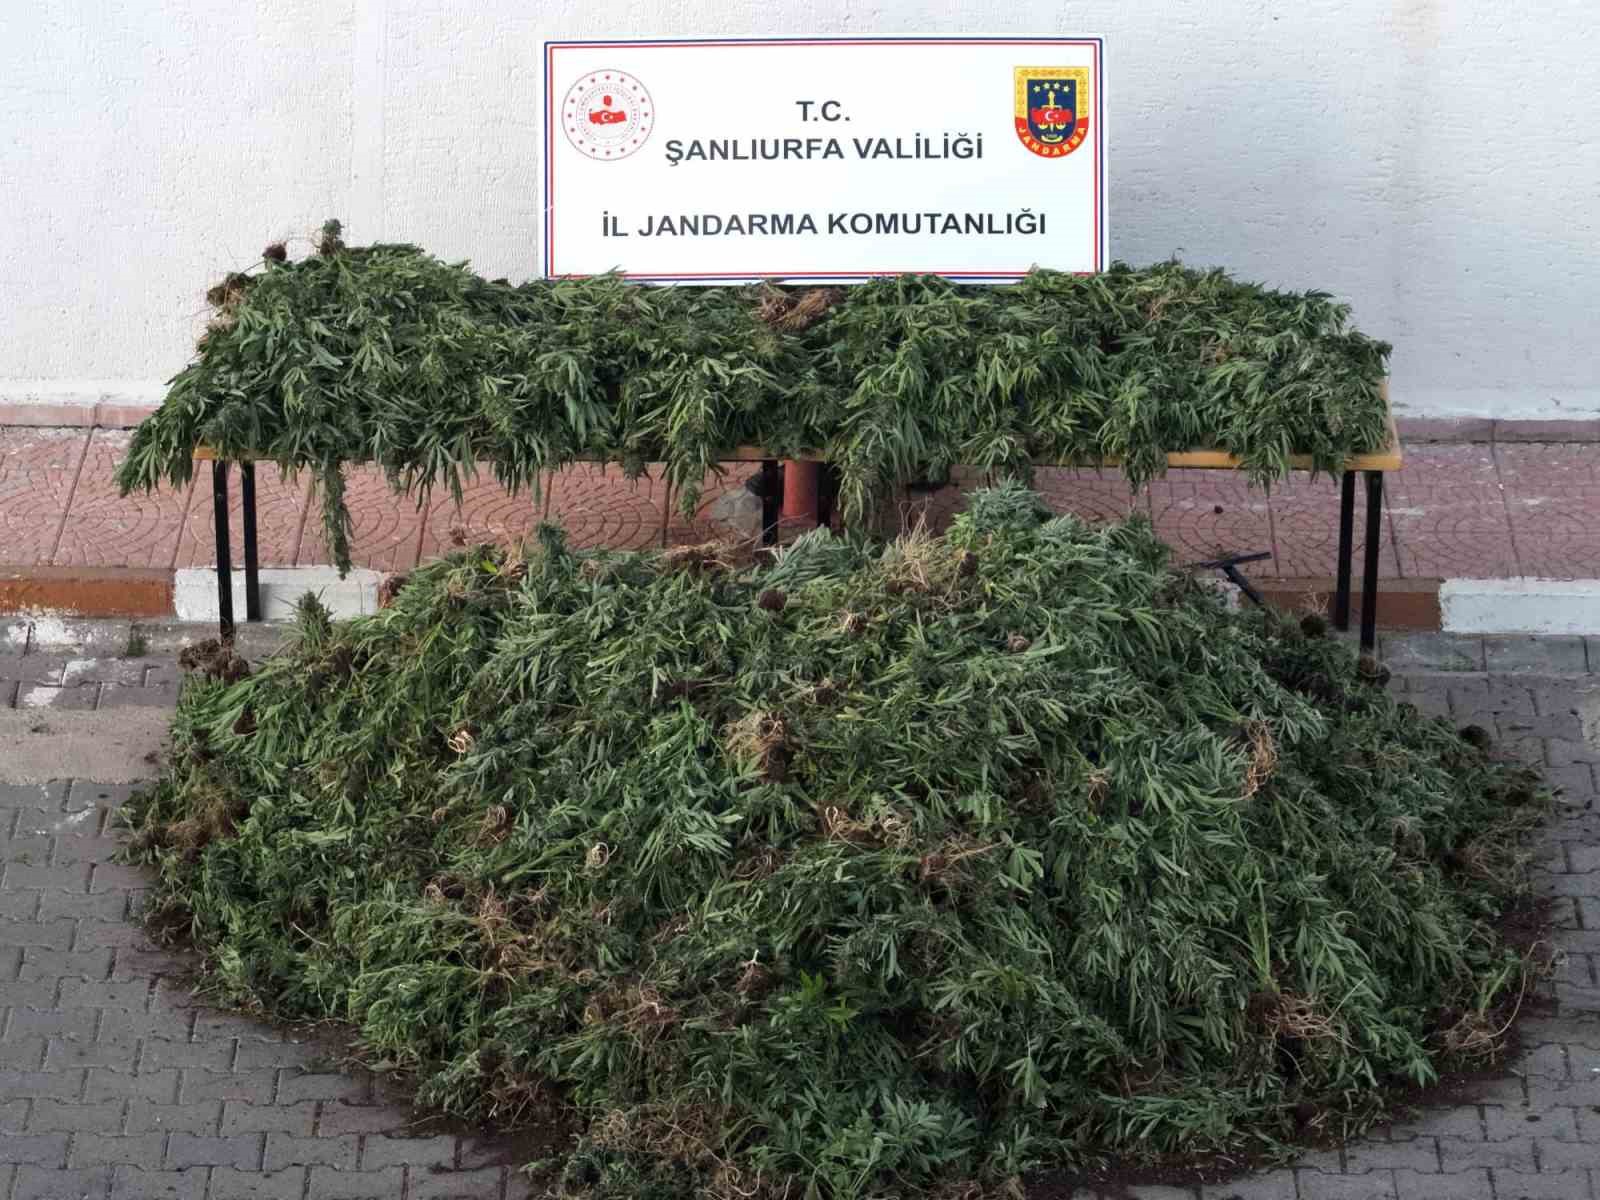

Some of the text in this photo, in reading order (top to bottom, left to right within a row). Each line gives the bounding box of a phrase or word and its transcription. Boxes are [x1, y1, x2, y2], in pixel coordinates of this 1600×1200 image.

[796, 100, 849, 122] T.C.
[666, 132, 982, 166] ŞANLIURFA VALİLİĞİ
[1018, 127, 1086, 155] JANDARMA
[603, 209, 1046, 237] İL JANDARMA KOMUTANLIĞI
